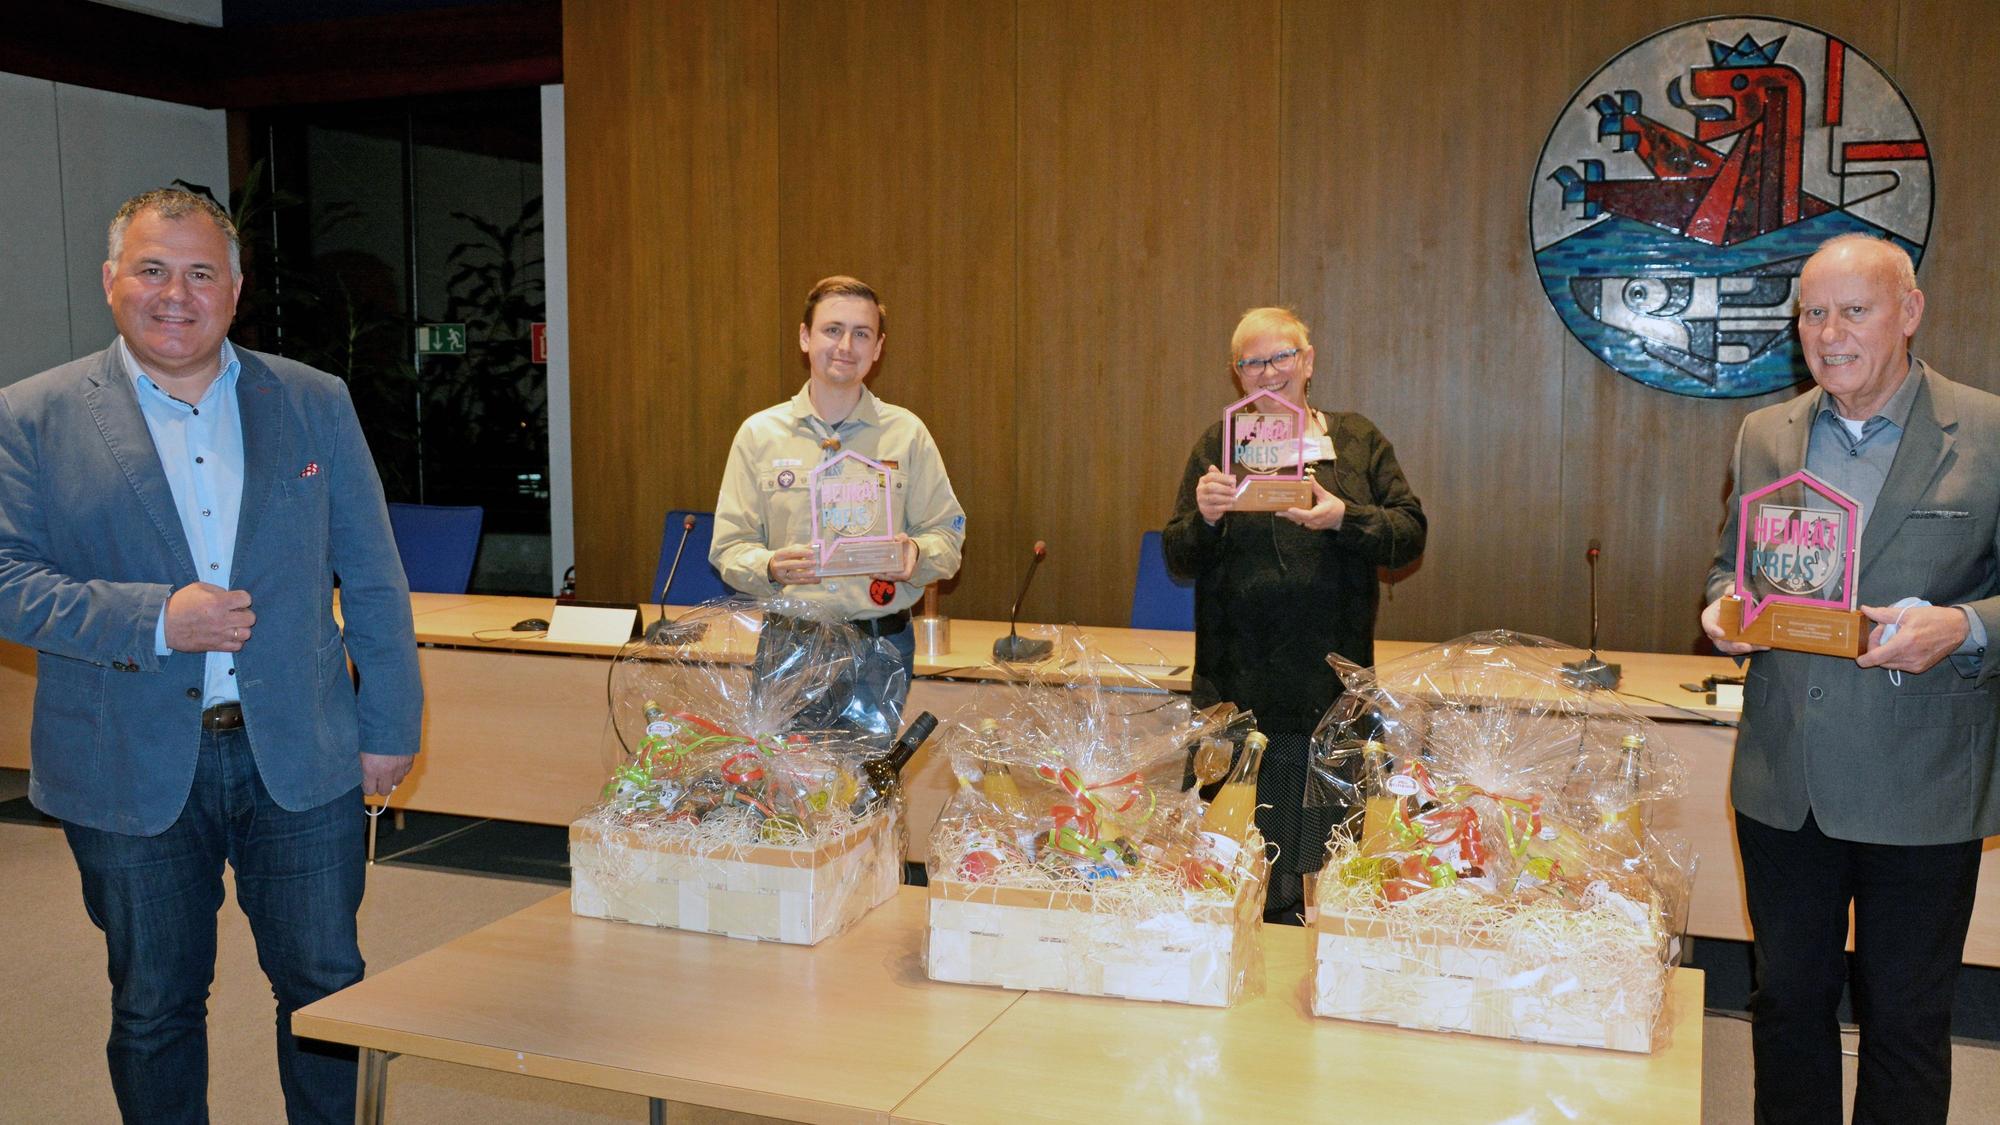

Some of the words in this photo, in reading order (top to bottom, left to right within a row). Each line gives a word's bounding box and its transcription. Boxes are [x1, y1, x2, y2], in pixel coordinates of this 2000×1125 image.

[1234, 445, 1280, 464] PREIS
[822, 508, 867, 529] PREIS
[1753, 515, 1838, 551] HEIMAT
[1751, 549, 1814, 581] PREIS
